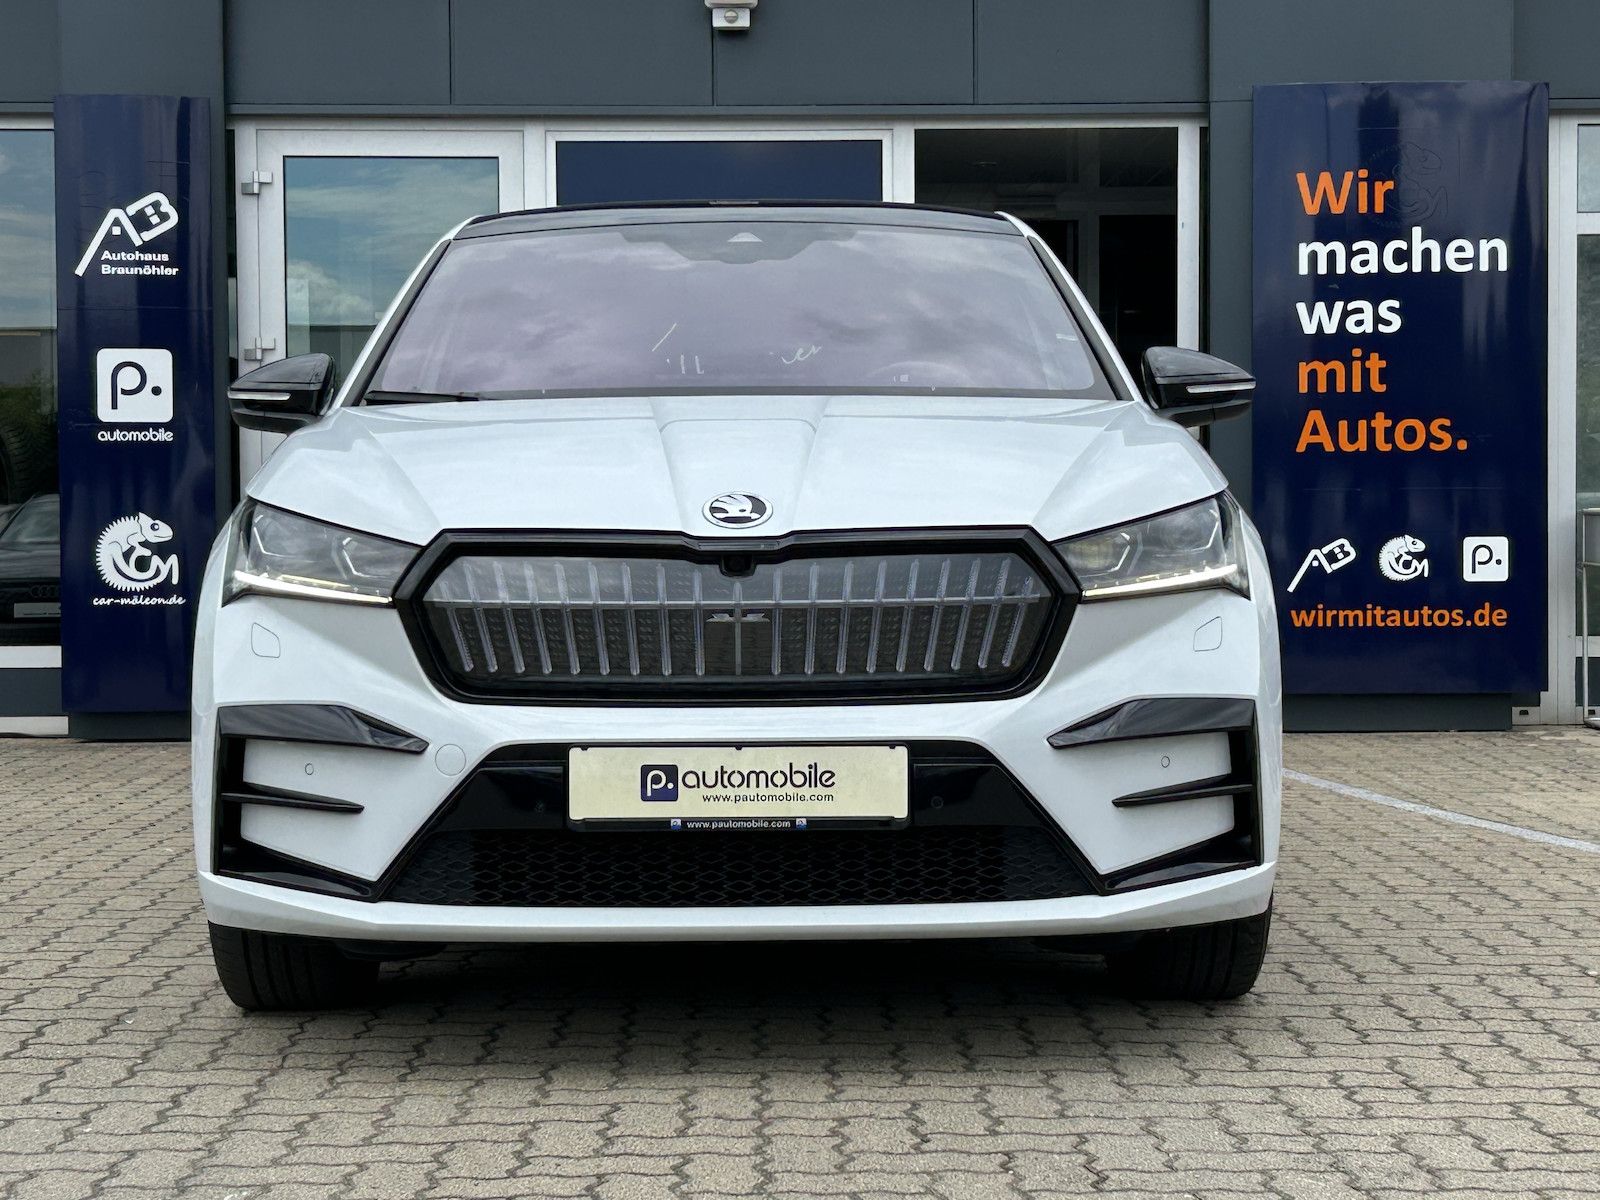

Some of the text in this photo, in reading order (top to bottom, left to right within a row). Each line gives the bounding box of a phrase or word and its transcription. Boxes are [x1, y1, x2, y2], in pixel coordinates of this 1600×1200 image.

[1296, 168, 1395, 216] Wir
[101, 250, 169, 262] Autohaus
[1298, 226, 1508, 275] machen
[101, 264, 179, 276] Braunöhler
[1296, 299, 1402, 334] was
[1298, 348, 1387, 393] mit
[97, 427, 174, 442] automobile
[1296, 409, 1468, 453] Autos.
[1290, 602, 1508, 628] wirmitautos.de
[681, 762, 836, 789] automobile
[702, 792, 834, 804] www.pautomobile.com
[686, 819, 791, 830] www.pautomobile.com
